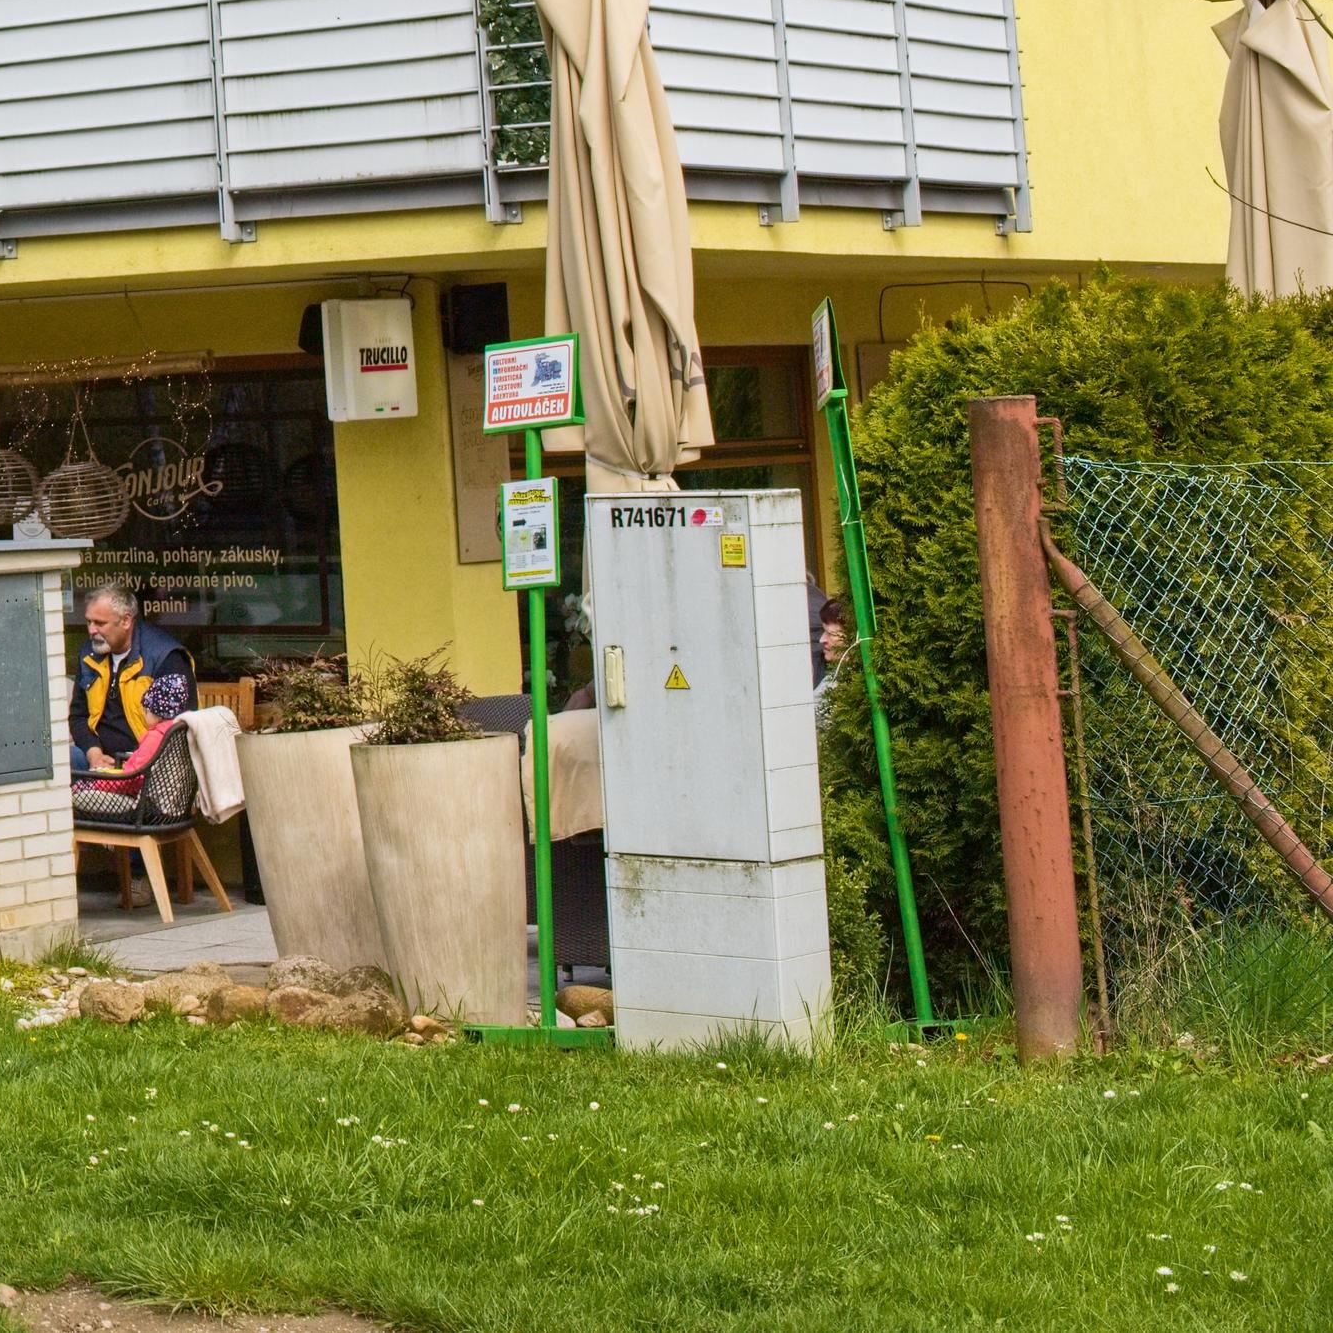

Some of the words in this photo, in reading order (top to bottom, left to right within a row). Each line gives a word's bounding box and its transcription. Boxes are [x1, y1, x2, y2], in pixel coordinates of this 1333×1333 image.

[359, 346, 408, 366] TRUCILLO
[491, 397, 565, 423] AUTOVLÁČEK
[114, 456, 224, 499] ONJOUR
[611, 507, 686, 528] R741671
[96, 547, 159, 565] zmrzlina,
[163, 547, 217, 567] poháry,
[220, 545, 284, 565] zákusky,
[150, 571, 219, 592] čepované
[223, 572, 259, 592] pivo,
[144, 597, 188, 616] panini
